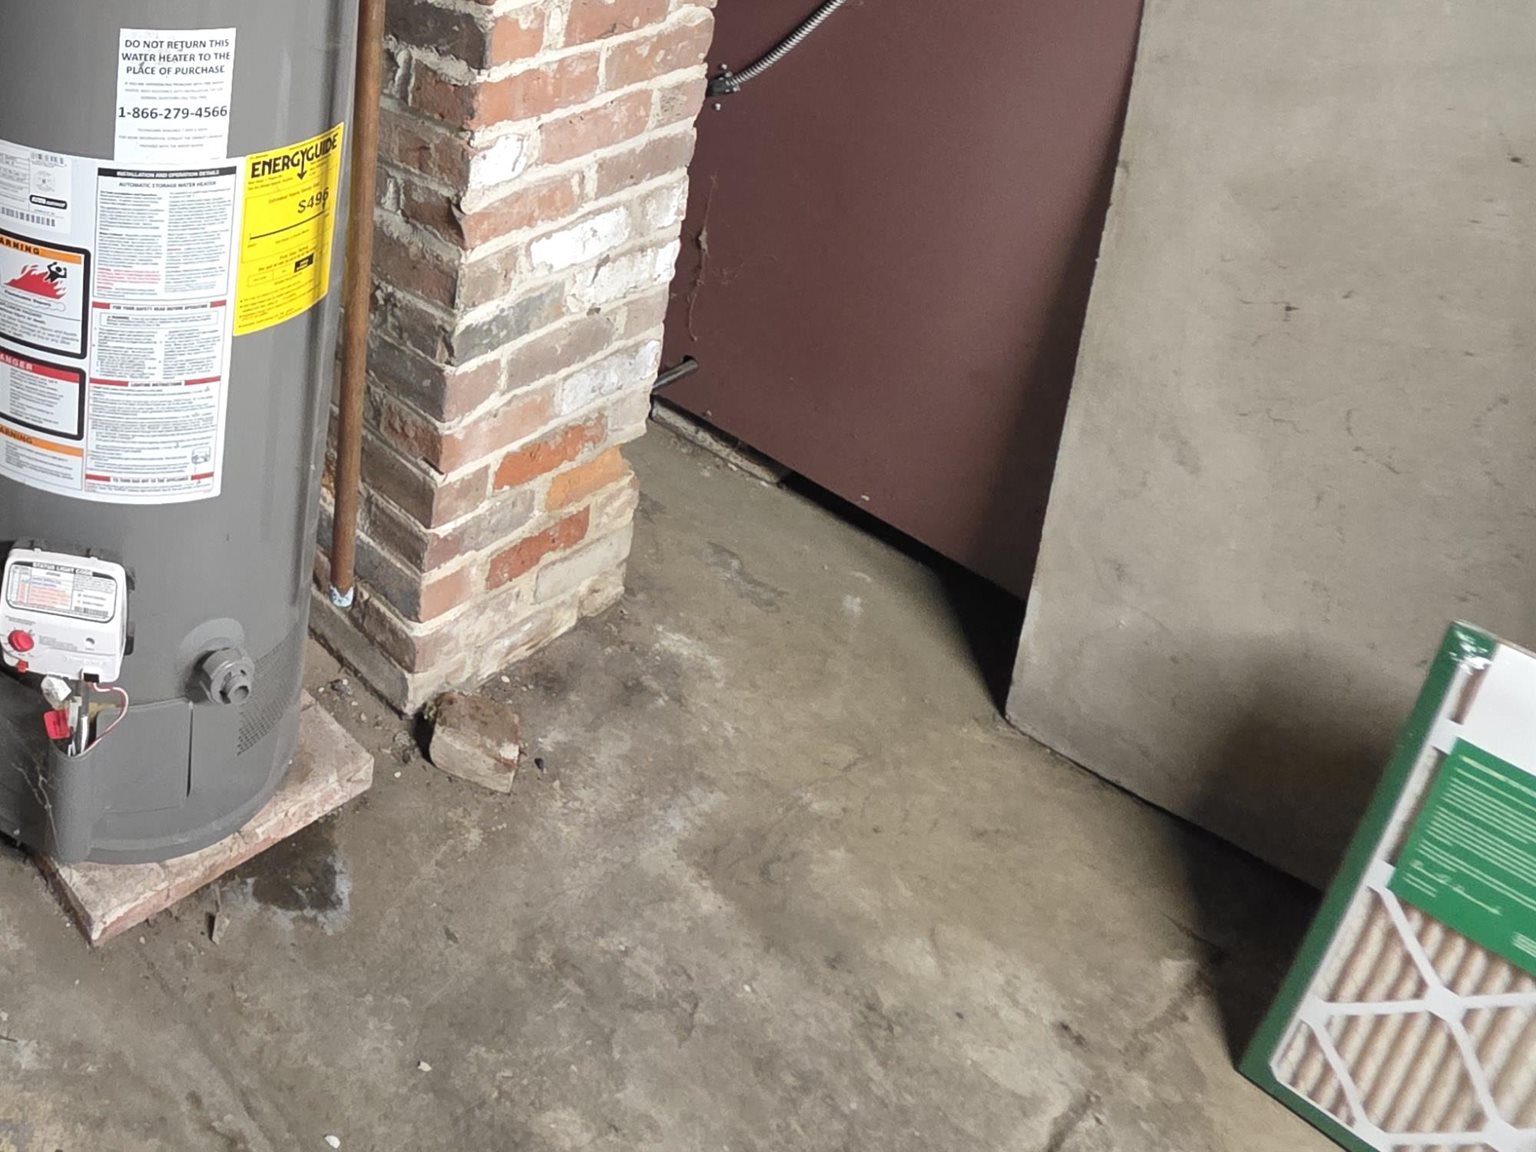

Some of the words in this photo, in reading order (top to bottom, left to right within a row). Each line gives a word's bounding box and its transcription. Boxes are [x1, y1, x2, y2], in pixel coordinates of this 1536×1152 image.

[124, 39, 141, 48] DO
[143, 40, 165, 49] NOT
[167, 40, 207, 50] RETURN
[209, 38, 230, 48] THIS
[121, 52, 156, 62] WATER
[158, 52, 196, 63] HEATER
[199, 53, 211, 62] TO
[213, 51, 231, 60] THE
[126, 65, 156, 75] PLACE
[158, 66, 173, 76] OF
[175, 65, 225, 76] PURCHASE
[118, 105, 228, 120] 1-866-279-4566
[251, 133, 338, 179] ENERGYGUIDE
